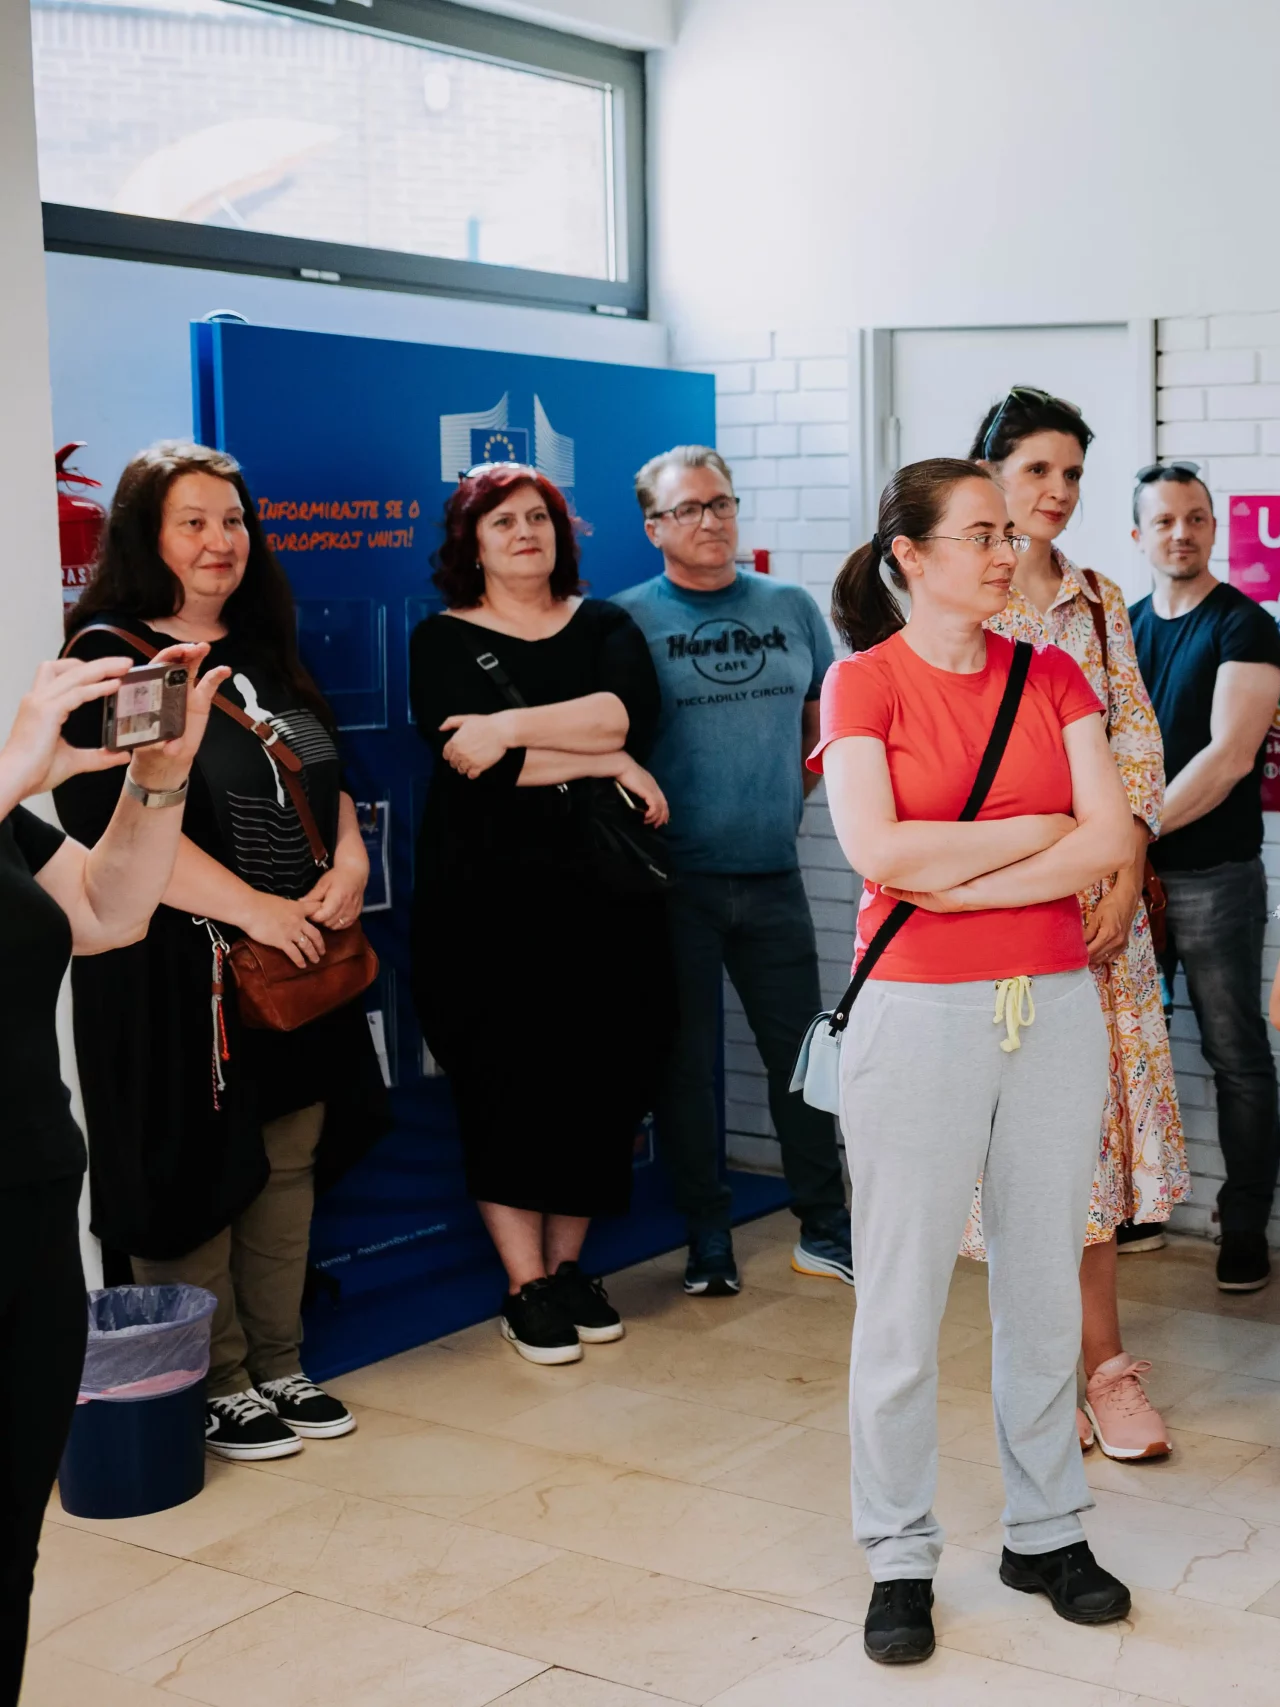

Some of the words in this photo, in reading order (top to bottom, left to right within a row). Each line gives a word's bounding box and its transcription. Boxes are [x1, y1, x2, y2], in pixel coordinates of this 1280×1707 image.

[385, 499, 403, 519] SE
[408, 499, 421, 519] O
[666, 630, 731, 660] Hard
[732, 624, 789, 657] Rock
[715, 660, 748, 673] CAFE
[676, 691, 748, 708] PICCADILLY
[751, 685, 795, 700] CIRCUS
